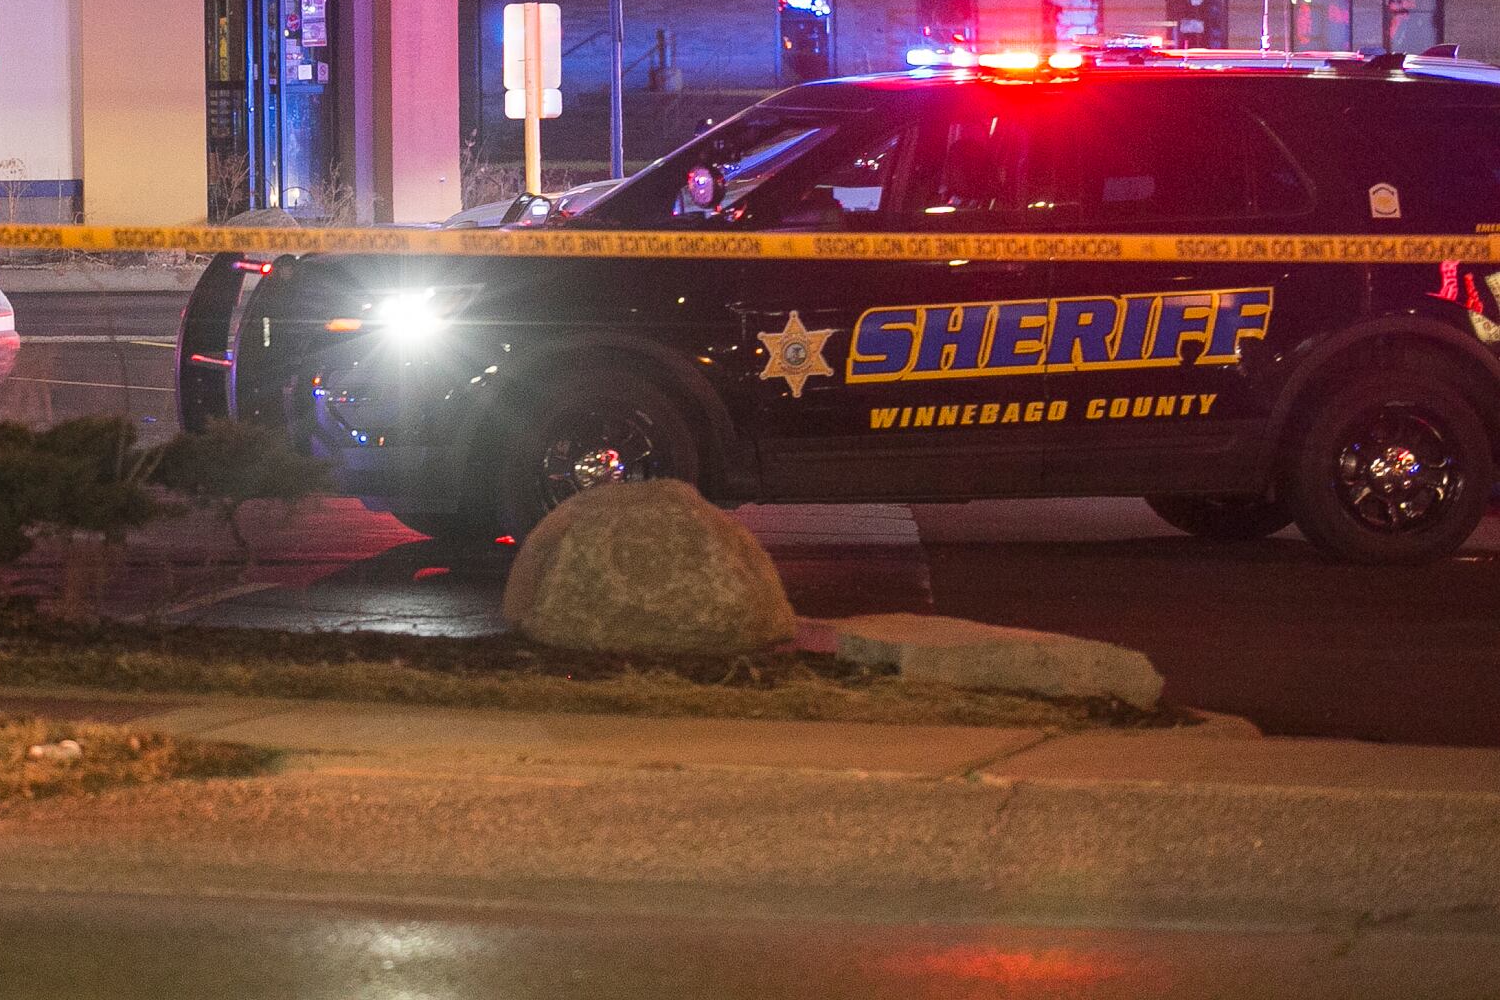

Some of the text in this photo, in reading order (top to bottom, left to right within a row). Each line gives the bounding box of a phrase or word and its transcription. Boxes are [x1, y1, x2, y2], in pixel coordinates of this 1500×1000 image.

[846, 287, 1274, 384] SHERIFF
[870, 394, 1217, 428] WINNEBAGO COUNTY
